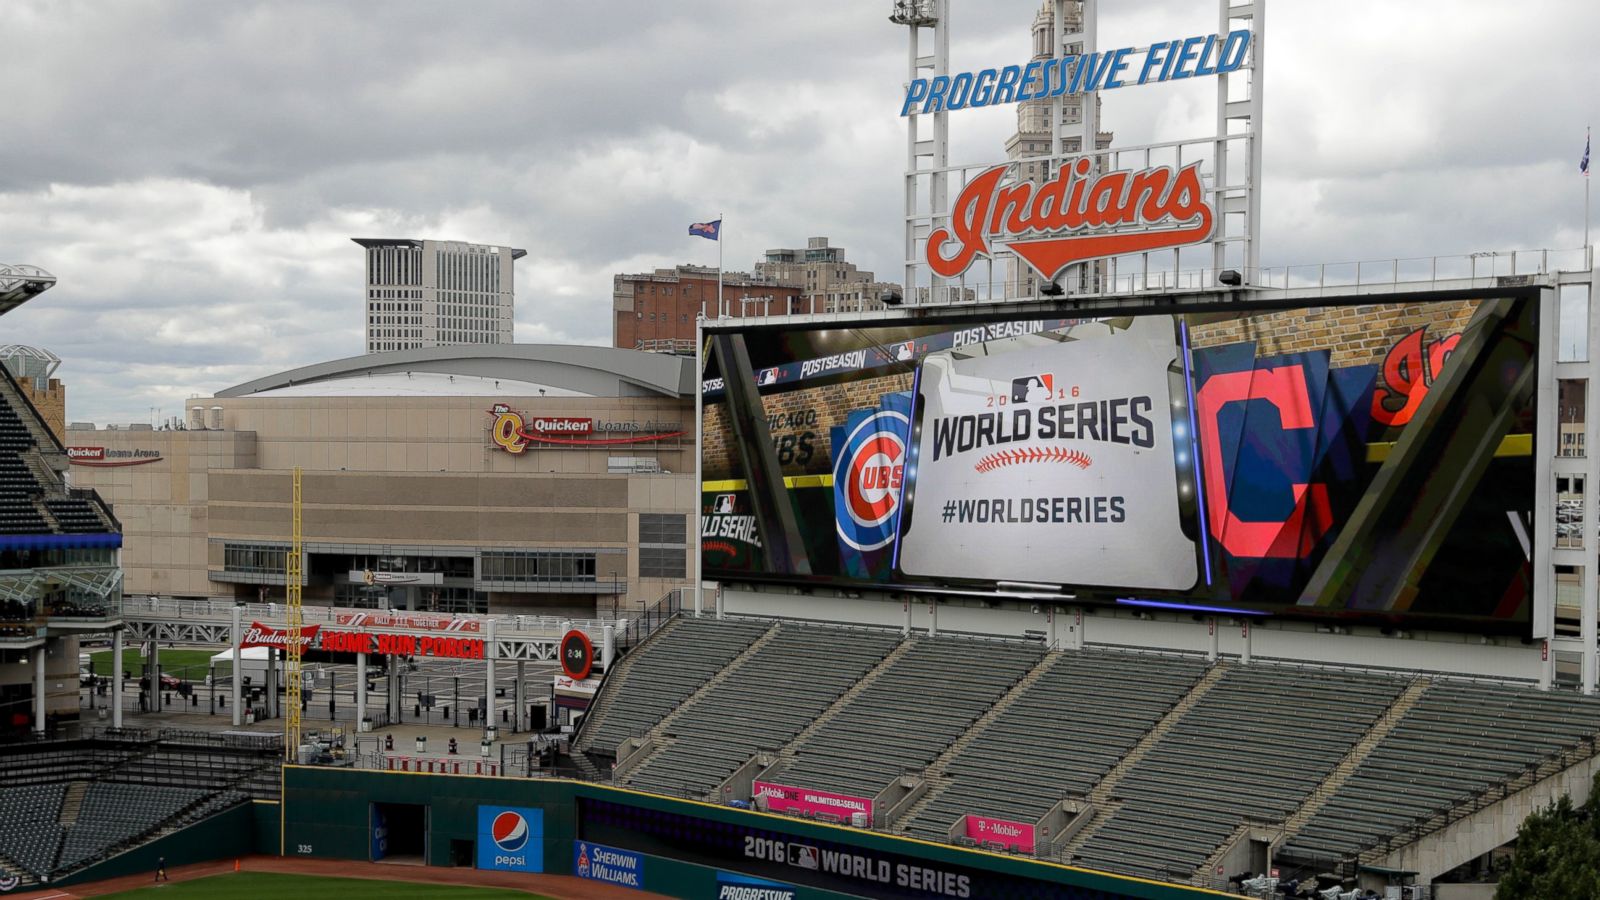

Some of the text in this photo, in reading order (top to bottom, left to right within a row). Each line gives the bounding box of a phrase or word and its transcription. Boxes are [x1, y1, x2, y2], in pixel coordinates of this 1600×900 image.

[900, 29, 1252, 117] PROGRESSIVE FIELD
[926, 156, 1217, 280] Indians
[800, 350, 866, 380] POSTSEASON
[493, 405, 526, 453] The Q
[534, 419, 590, 431] Quicken
[596, 419, 640, 432] Loans
[933, 395, 1155, 462] WORLD SERIES
[67, 447, 102, 457] Quicken
[134, 448, 160, 458] Arena
[942, 496, 1126, 523] #WORLDSERIES
[375, 616, 390, 625] RALLY
[413, 618, 440, 627] TOGETHER
[243, 628, 312, 645] Budwer
[321, 631, 484, 660] HOME RUN PORCH
[297, 844, 312, 853] 325
[495, 855, 526, 867] pepsi
[593, 847, 637, 870] SHERWIN
[744, 836, 971, 898] 2016 WORLD SERIES
[719, 885, 794, 900] PROGRESSIVE
